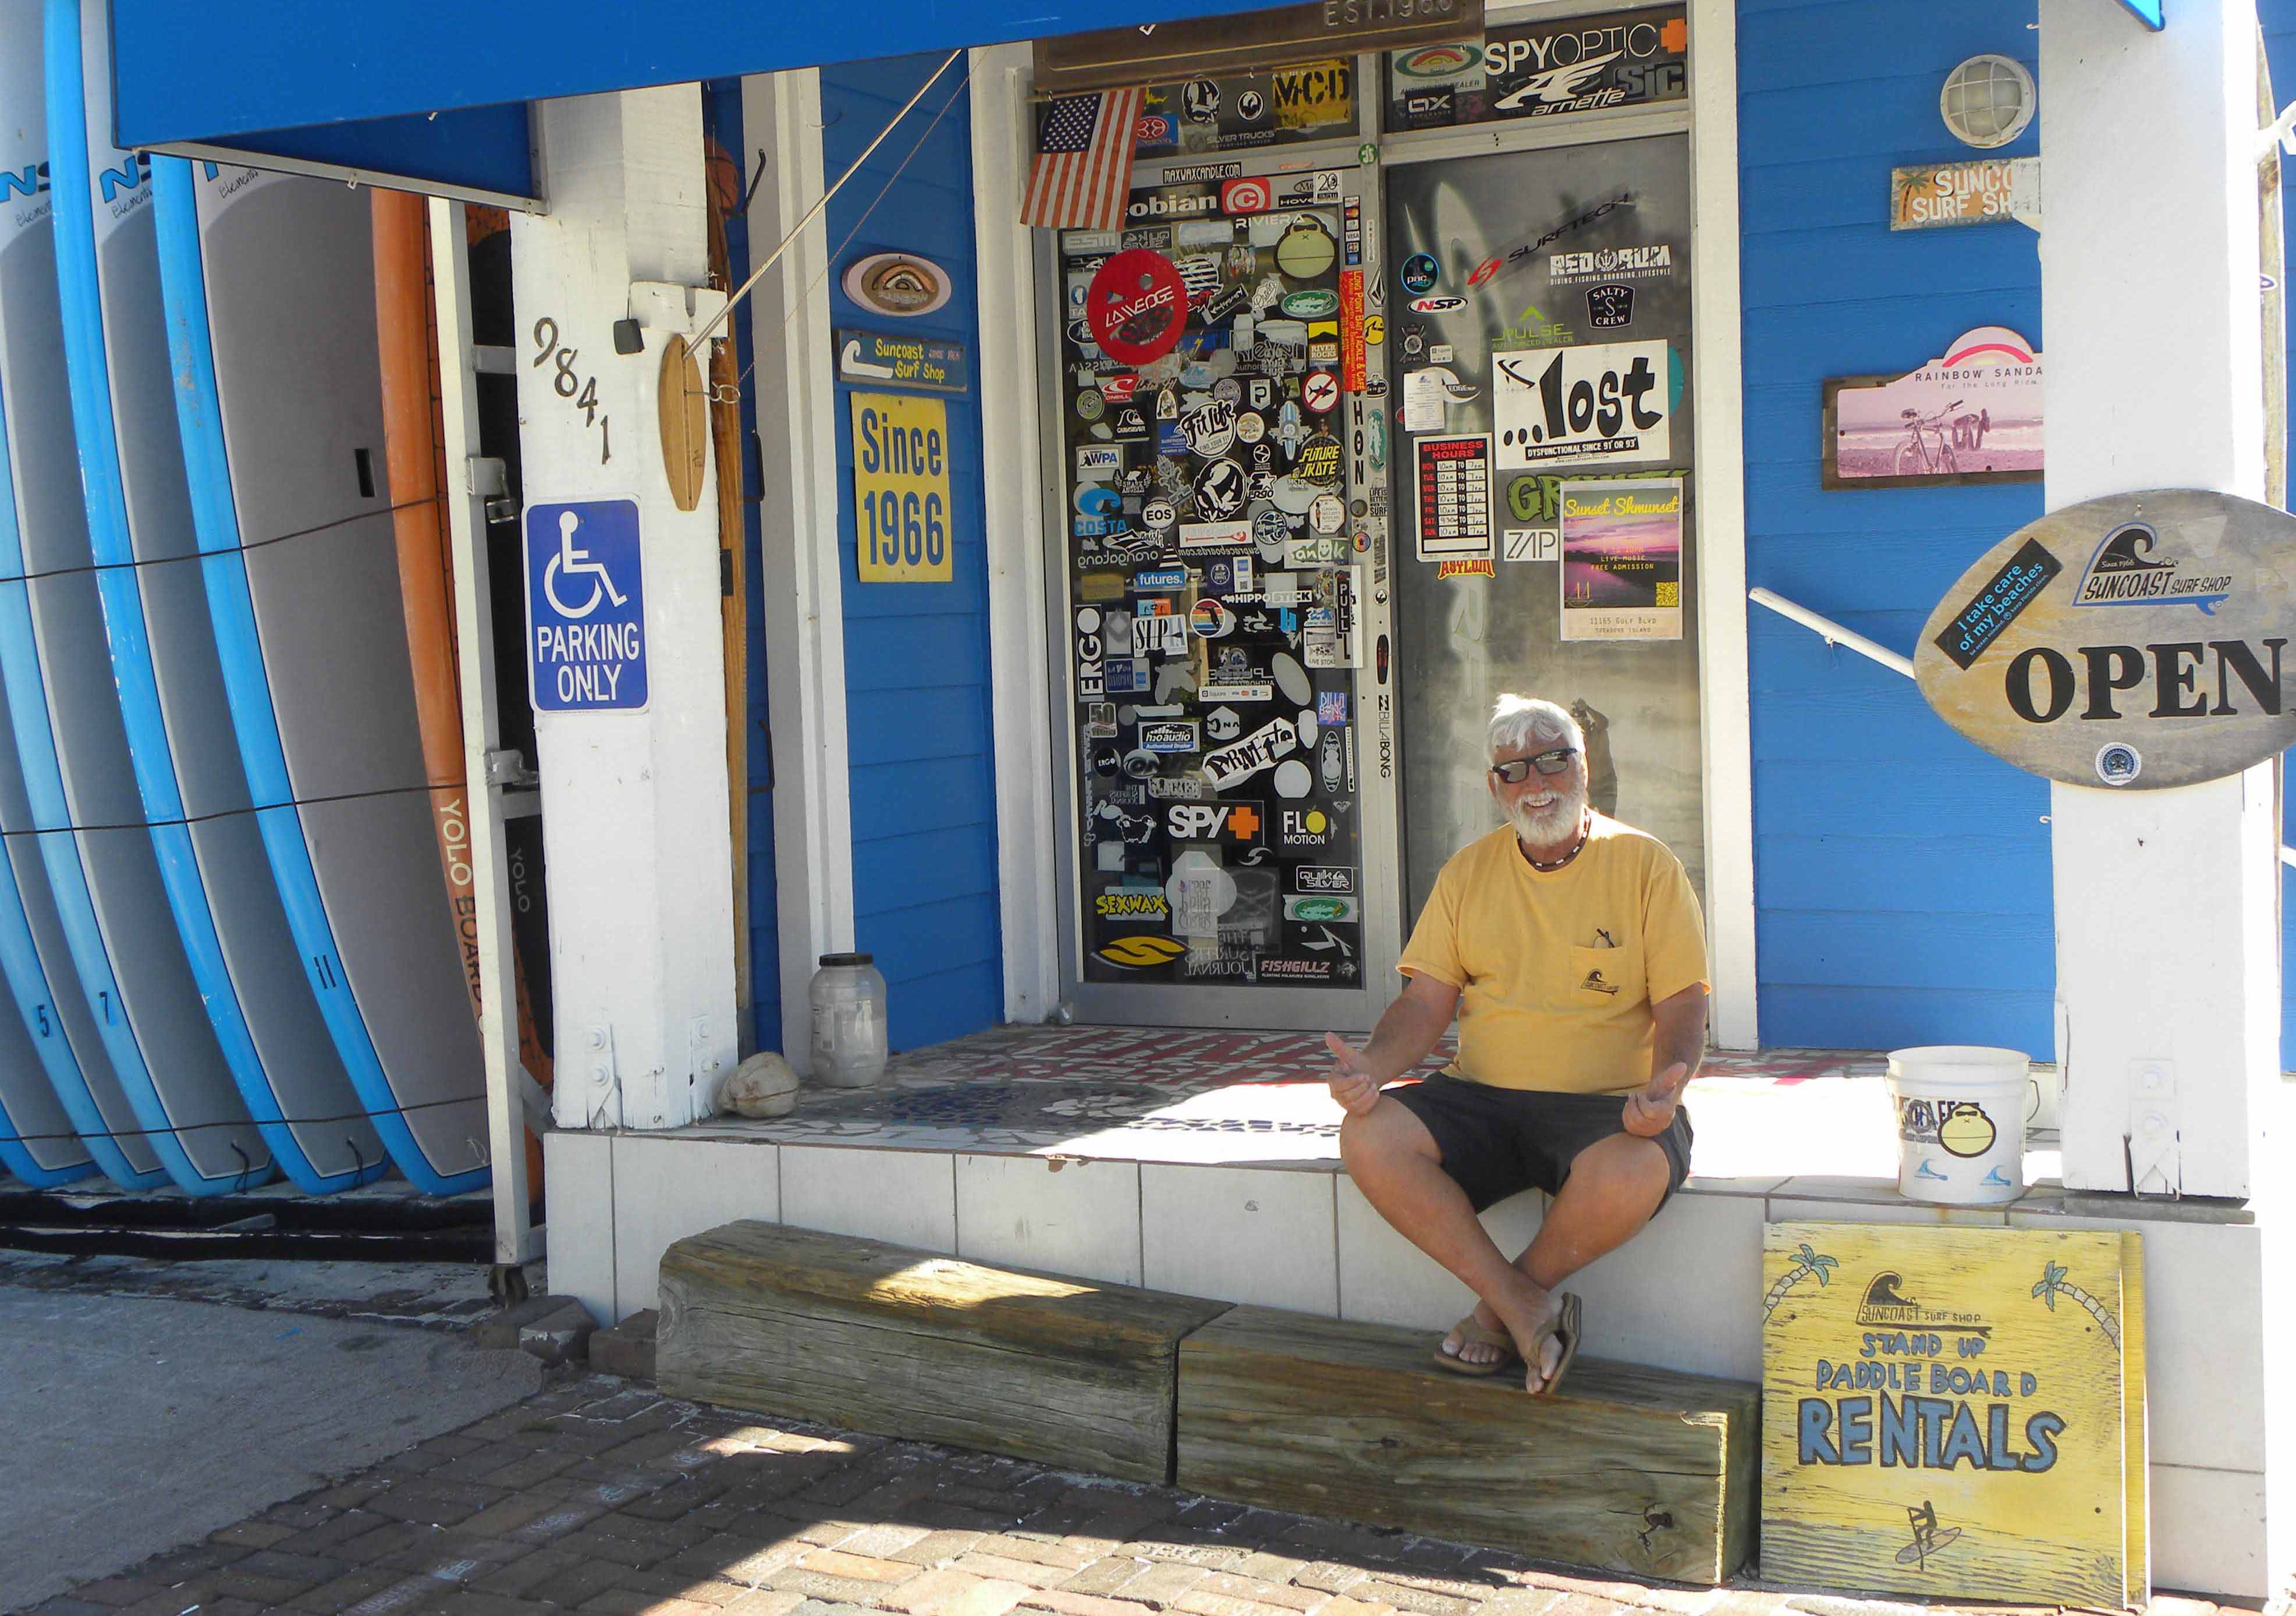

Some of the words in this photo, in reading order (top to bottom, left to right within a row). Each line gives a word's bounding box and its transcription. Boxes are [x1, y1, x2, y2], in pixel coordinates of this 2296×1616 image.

[1239, 130, 1275, 140] TRUCKS
[1164, 164, 1240, 183] MAXWAXCANDLE.COM
[1127, 193, 1218, 217] obian
[1912, 195, 1971, 223] SURF
[1235, 213, 1305, 229] RIVIERA
[1550, 252, 1594, 276] RED
[1618, 244, 1671, 271] RUM
[1354, 270, 1362, 291] LONG
[1354, 292, 1363, 313] POINT
[1592, 287, 1628, 300] SALTY
[1417, 299, 1461, 312] NSP
[1595, 315, 1626, 325] CREW
[875, 338, 924, 360] Suncoast
[1311, 344, 1336, 352] RIVER
[1311, 350, 1337, 359] ROCKS
[895, 360, 920, 379] Surf
[923, 363, 945, 384] Shop
[1915, 370, 1983, 382] RAINBOW
[861, 407, 942, 477] Since
[1423, 441, 1484, 452] BUSINESS
[1527, 444, 1581, 458] DYSFUNCTIONAL
[1582, 442, 1601, 452] SINCE
[1614, 441, 1624, 449] OR
[1298, 445, 1340, 463] FUTURE
[1432, 449, 1475, 459] HOURS
[1300, 460, 1337, 477] SKATE
[1146, 509, 1172, 521] EOS
[1369, 506, 1387, 515] SURF
[1564, 498, 1612, 517] Sunset
[1613, 495, 1680, 516] Shmunset
[864, 490, 944, 566] 1966
[1074, 518, 1127, 536] COSTA
[1506, 532, 1556, 559] ZAP
[1613, 563, 1654, 571] ADMISSION
[2118, 558, 2135, 568] 1966
[1139, 571, 1183, 584] futures.
[2084, 571, 2174, 600] SUNCOAST
[2171, 577, 2201, 594] SURF
[2200, 576, 2232, 593] SHOP
[1340, 583, 1349, 631] PULL
[1957, 621, 1968, 631] I
[1965, 594, 1995, 624] take
[1994, 564, 2022, 594] care
[1959, 633, 1975, 651] of
[1972, 614, 1995, 637] my
[1990, 562, 2044, 616] beaches
[537, 622, 640, 663] PARKING
[557, 663, 622, 703] ONLY
[2005, 638, 2288, 723] OPEN
[1163, 731, 1191, 742] audio
[1378, 711, 1391, 779] BILLABONG
[1168, 805, 1230, 839] SPY
[1282, 810, 1327, 834] FLO
[439, 798, 473, 886] YOLO
[1283, 834, 1326, 845] MOTION
[509, 847, 530, 914] YOLO
[1095, 893, 1169, 917] SEXWAX
[1261, 960, 1330, 974] FISHGILLZ
[1862, 1305, 1919, 1323] SUNCOAST
[1924, 1311, 1947, 1322] SURF
[1953, 1313, 1981, 1323] SHOP
[1859, 1331, 1943, 1358] STAND
[1957, 1336, 1986, 1359] UP
[1816, 1359, 1922, 1393] PADDLE
[1798, 1388, 2067, 1474] RENTALS
